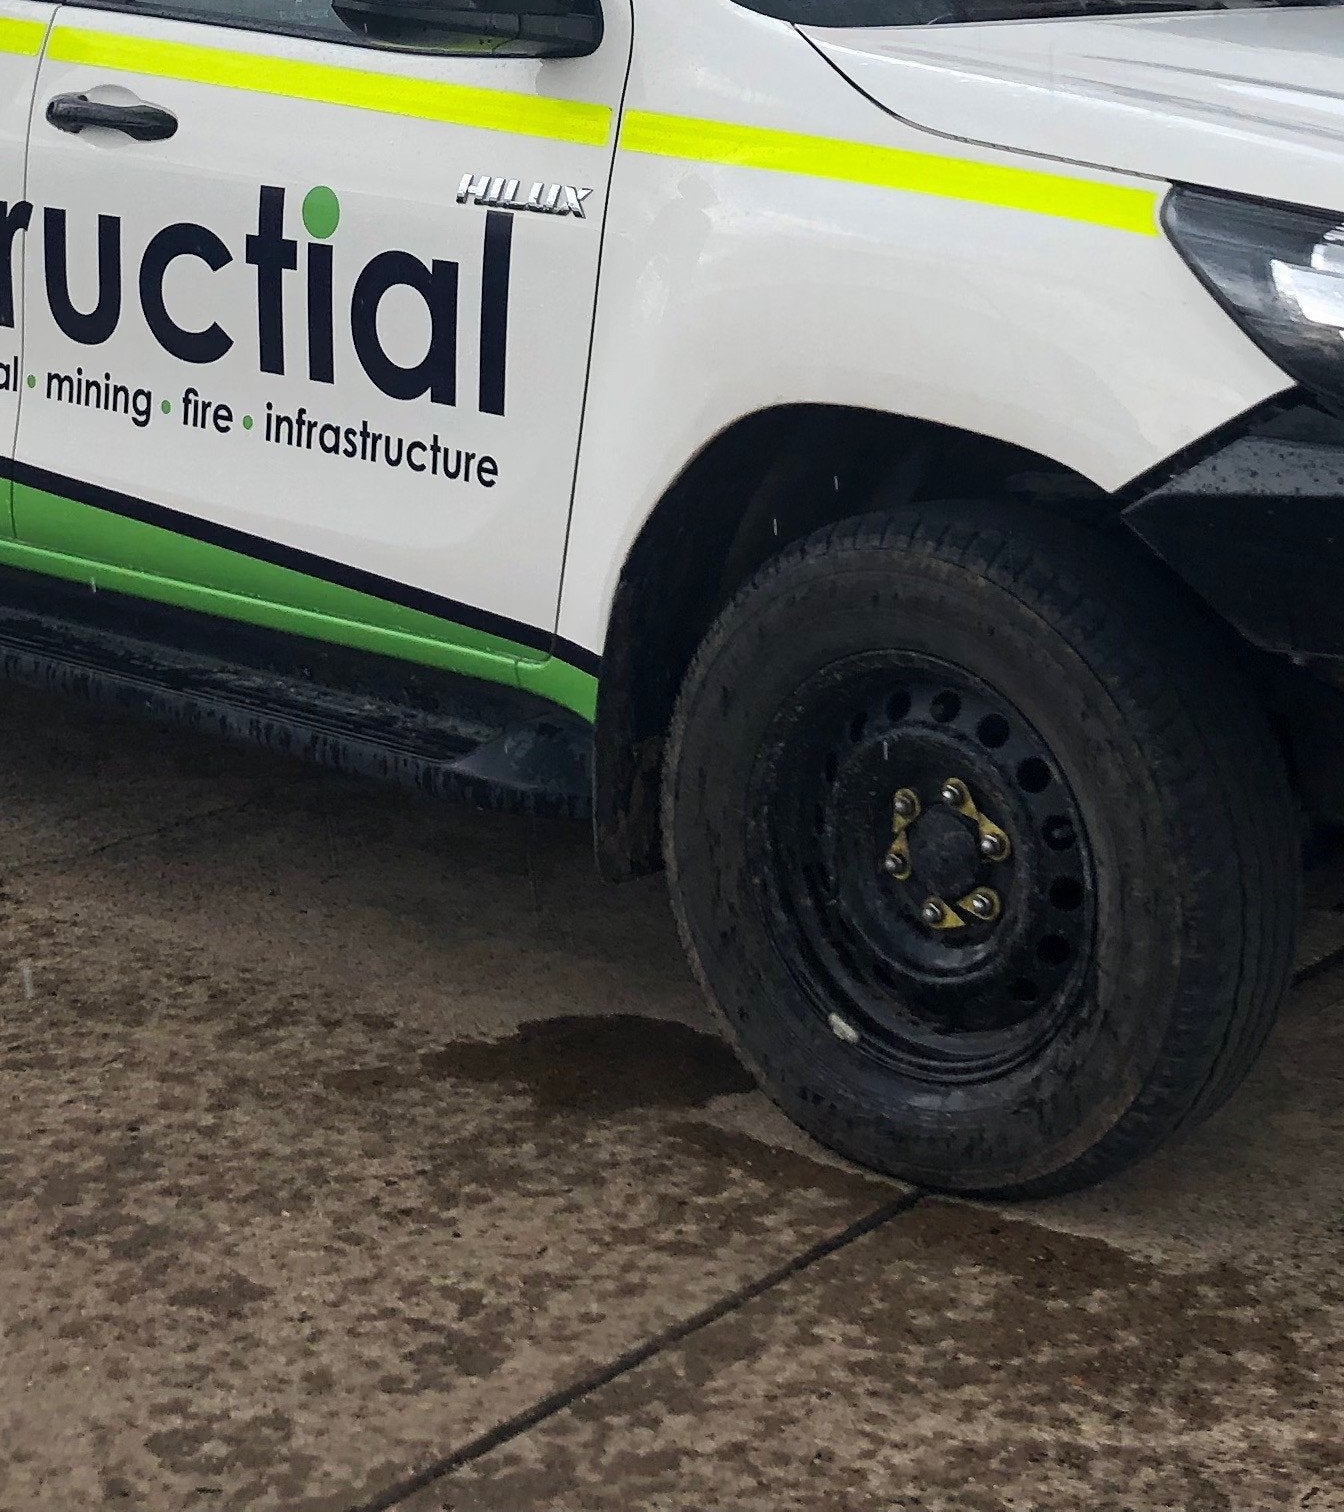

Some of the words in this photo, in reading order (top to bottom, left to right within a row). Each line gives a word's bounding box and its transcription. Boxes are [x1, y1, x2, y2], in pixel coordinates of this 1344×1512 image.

[456, 173, 594, 219] HILUX
[46, 366, 153, 428] mining
[182, 387, 234, 433] fire
[265, 401, 499, 488] infrastructure
